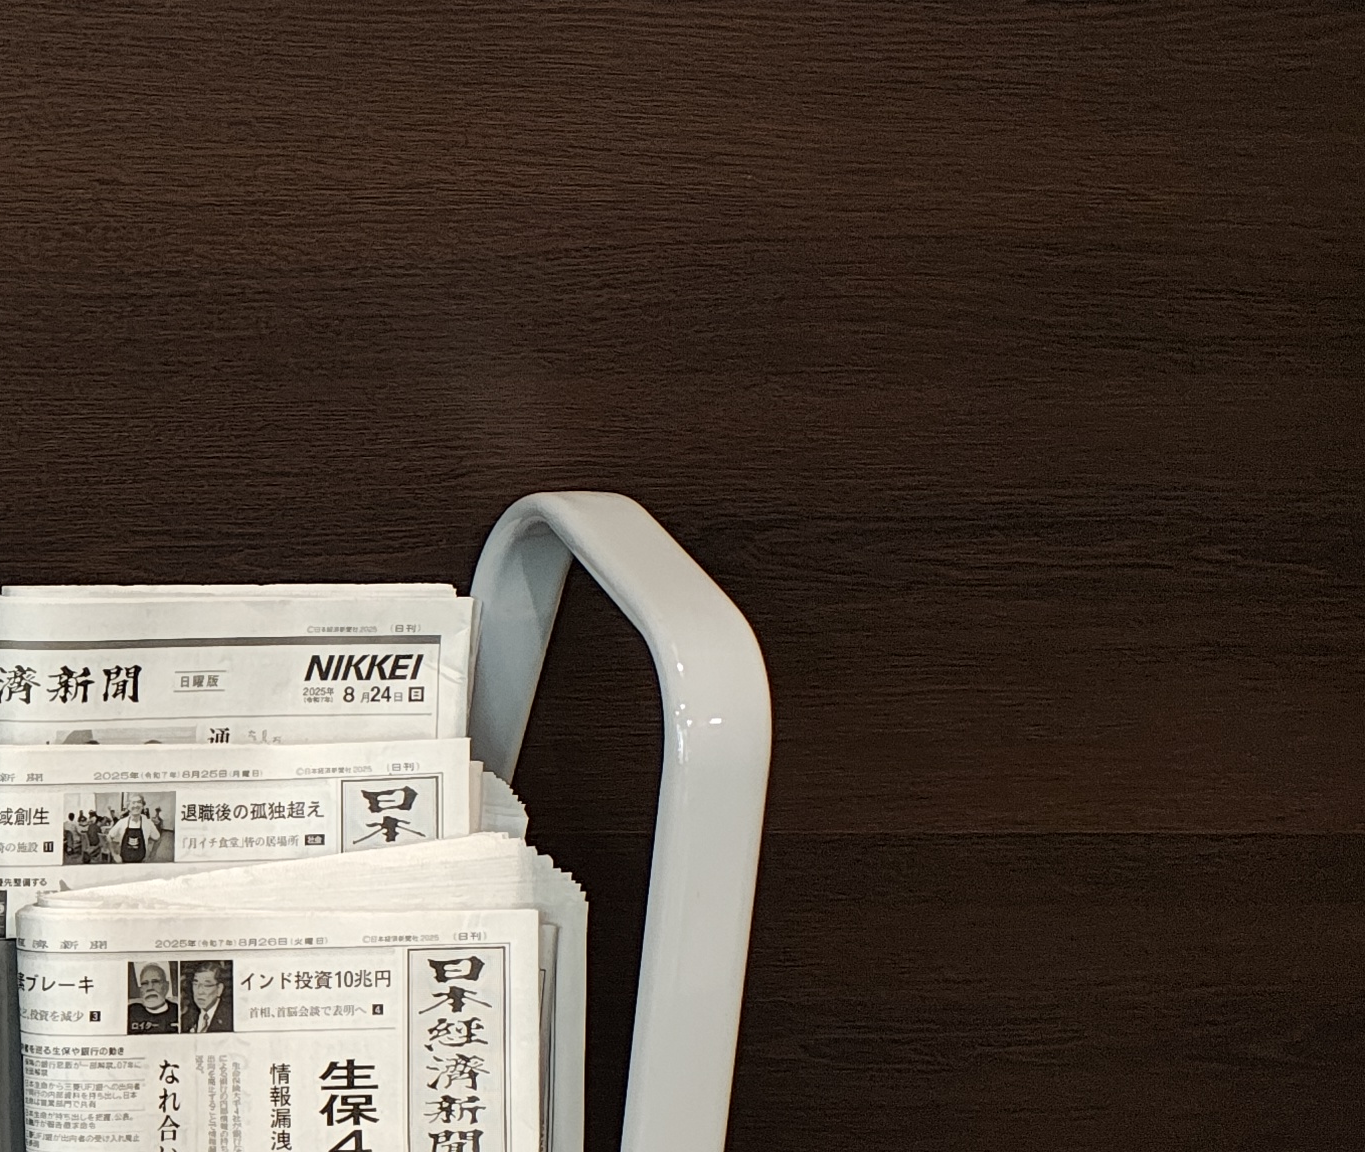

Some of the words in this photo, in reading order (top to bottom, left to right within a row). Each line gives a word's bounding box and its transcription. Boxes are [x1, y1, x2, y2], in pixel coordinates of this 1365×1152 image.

[304, 654, 424, 681] NIKKEI
[180, 674, 219, 688] 日曜版
[303, 687, 334, 697] 2025年
[180, 801, 325, 822] 退職後の孤独超え
[240, 969, 392, 991] インド投資10兆円
[131, 1021, 160, 1030] ロイター
